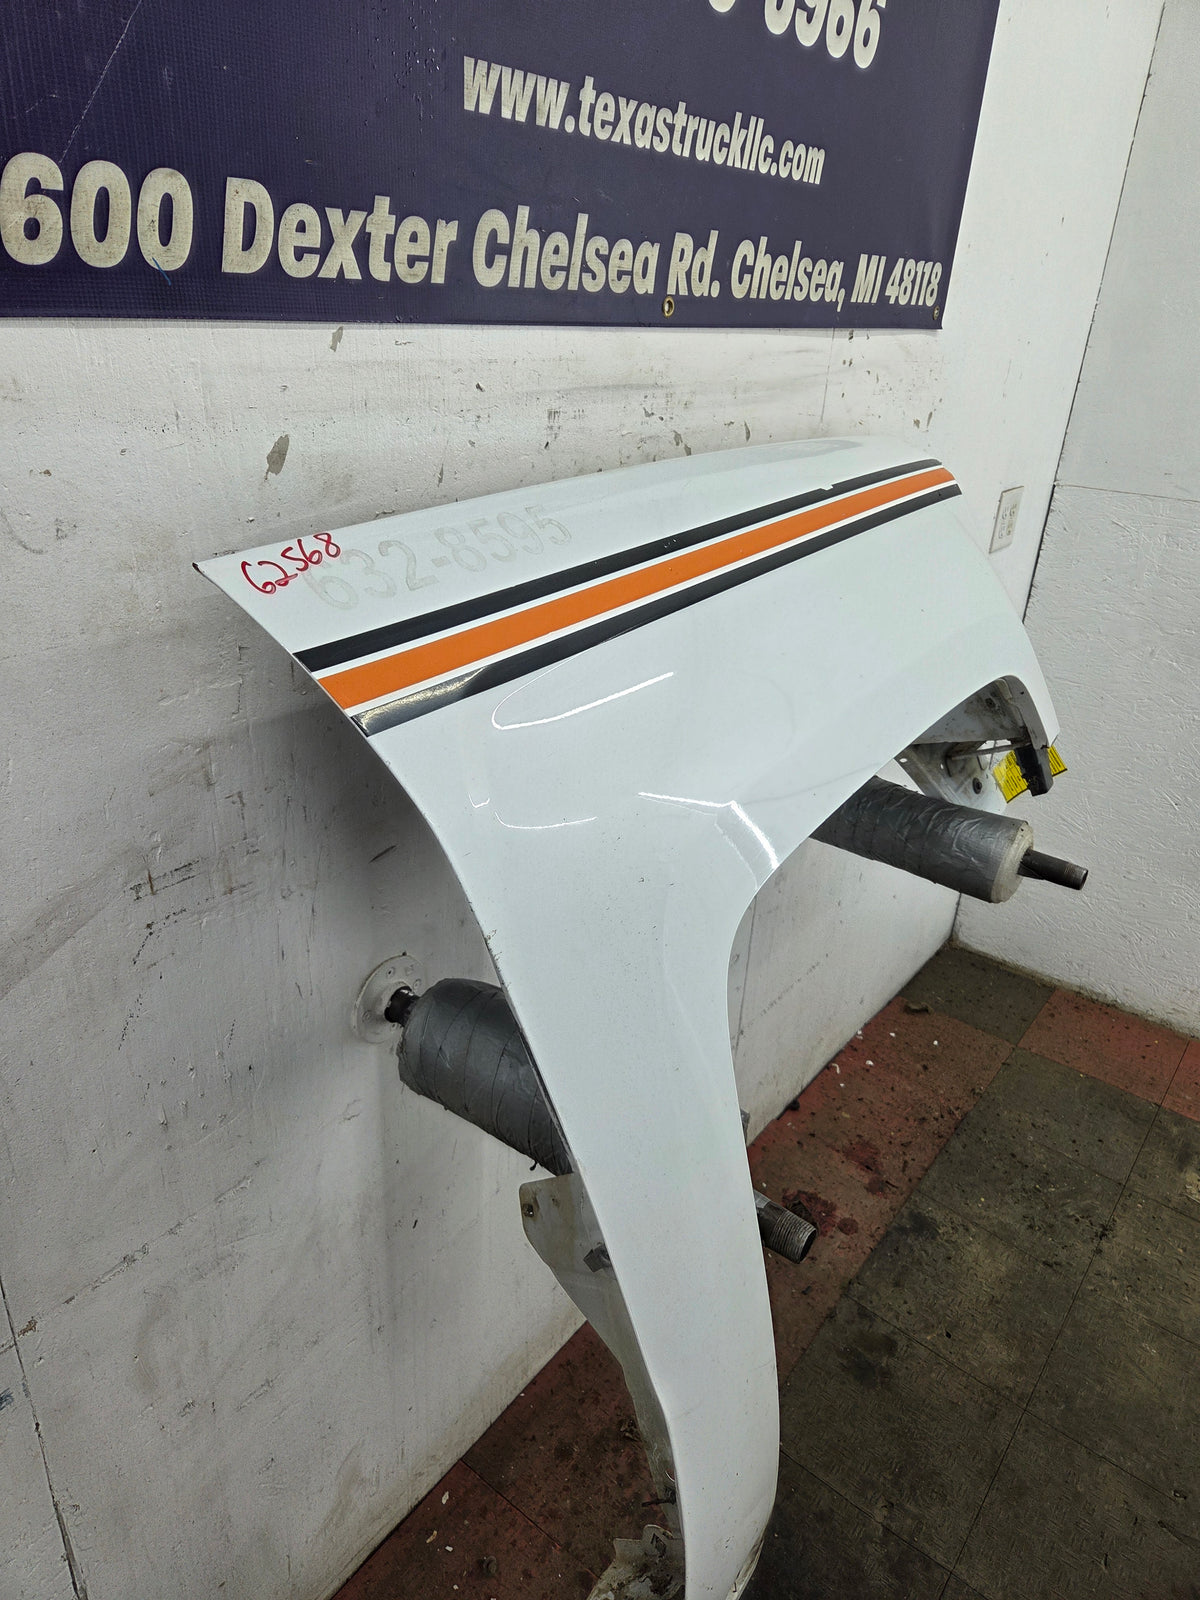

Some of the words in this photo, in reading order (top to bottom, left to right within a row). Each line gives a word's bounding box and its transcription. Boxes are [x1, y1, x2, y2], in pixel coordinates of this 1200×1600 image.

[463, 55, 826, 185] www.texastruckllc.com
[0, 151, 194, 271] 600
[221, 176, 458, 285] Dexter
[472, 204, 661, 294] Chelsea
[666, 229, 721, 298] Rd.
[730, 235, 846, 313] Chelsea,
[850, 253, 887, 304] MI
[885, 257, 943, 307] 48118
[240, 532, 342, 595] 62568
